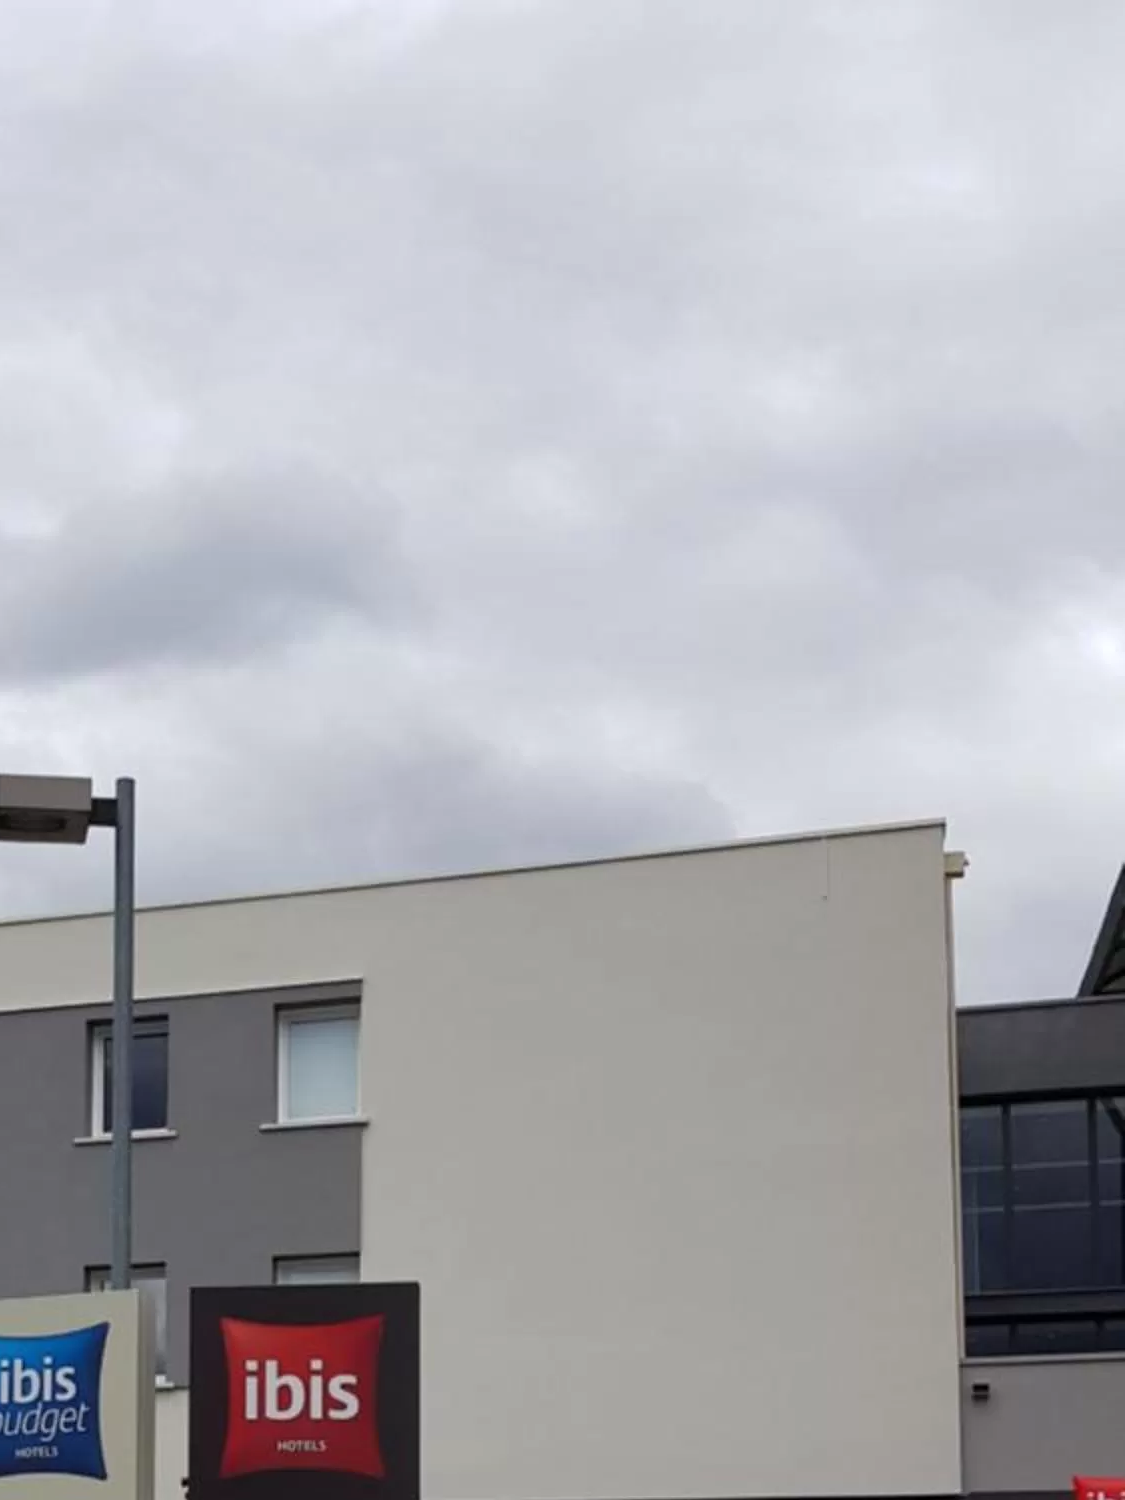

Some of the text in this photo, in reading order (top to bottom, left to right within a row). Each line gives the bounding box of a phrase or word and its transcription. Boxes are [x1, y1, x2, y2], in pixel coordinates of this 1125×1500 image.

[0, 1356, 77, 1404] ibis
[244, 1358, 360, 1420] ibis
[14, 1445, 59, 1459] HOTELS
[277, 1439, 327, 1452] HOTELS
